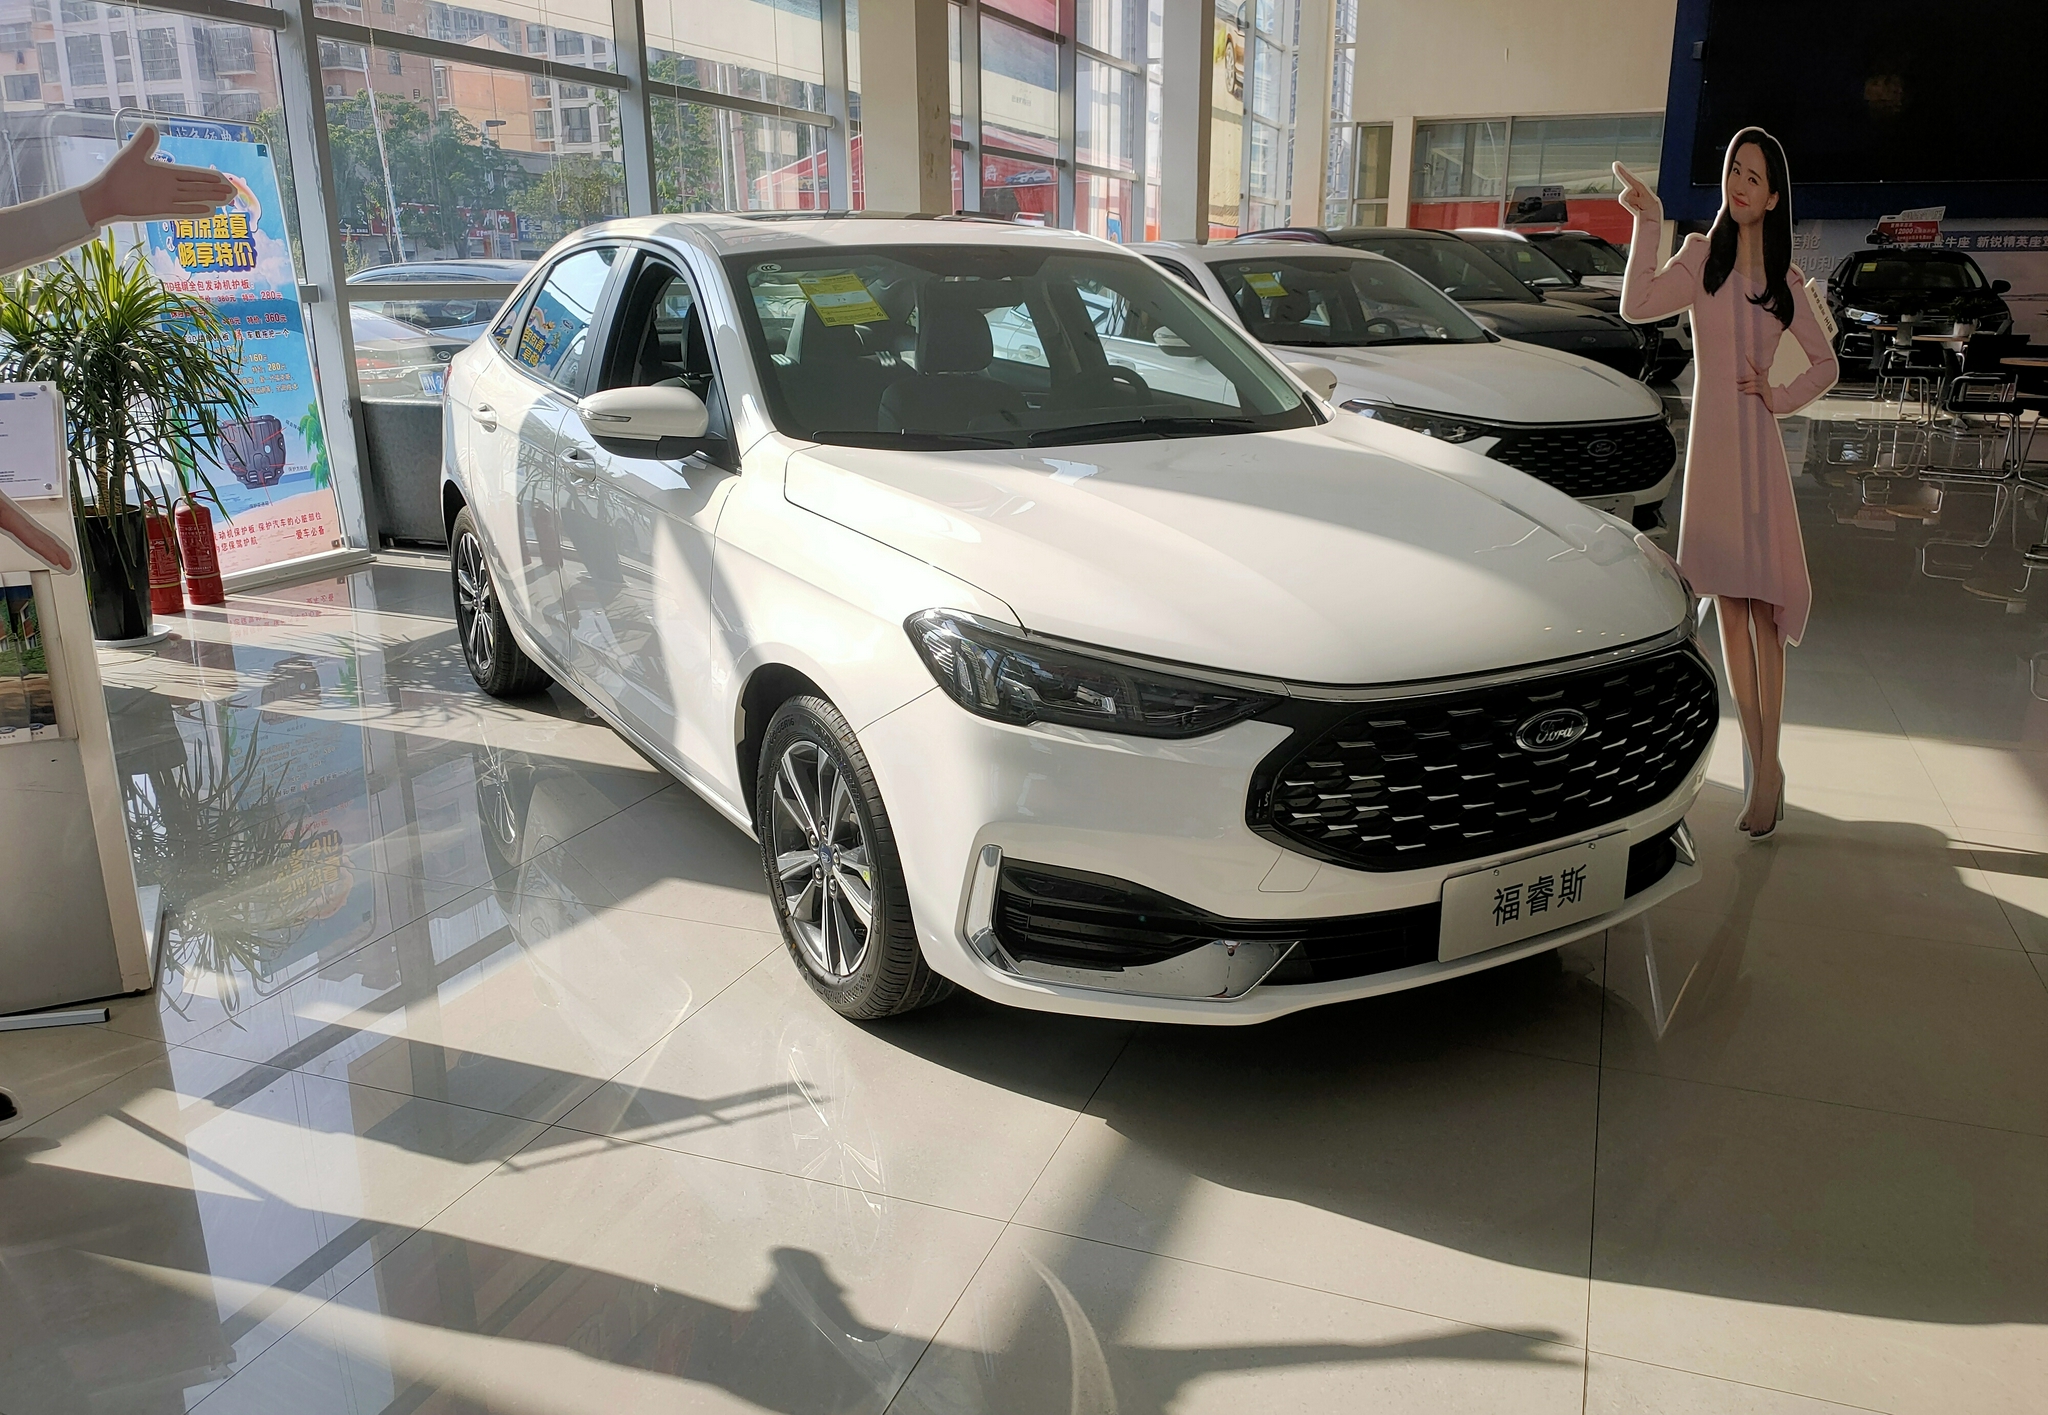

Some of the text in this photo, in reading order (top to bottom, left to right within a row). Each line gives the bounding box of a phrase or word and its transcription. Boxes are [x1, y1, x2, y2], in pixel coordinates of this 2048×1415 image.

[178, 242, 255, 268] 畅享特价
[1536, 717, 1575, 744] Ford
[1492, 864, 1587, 927] 福睿斯
